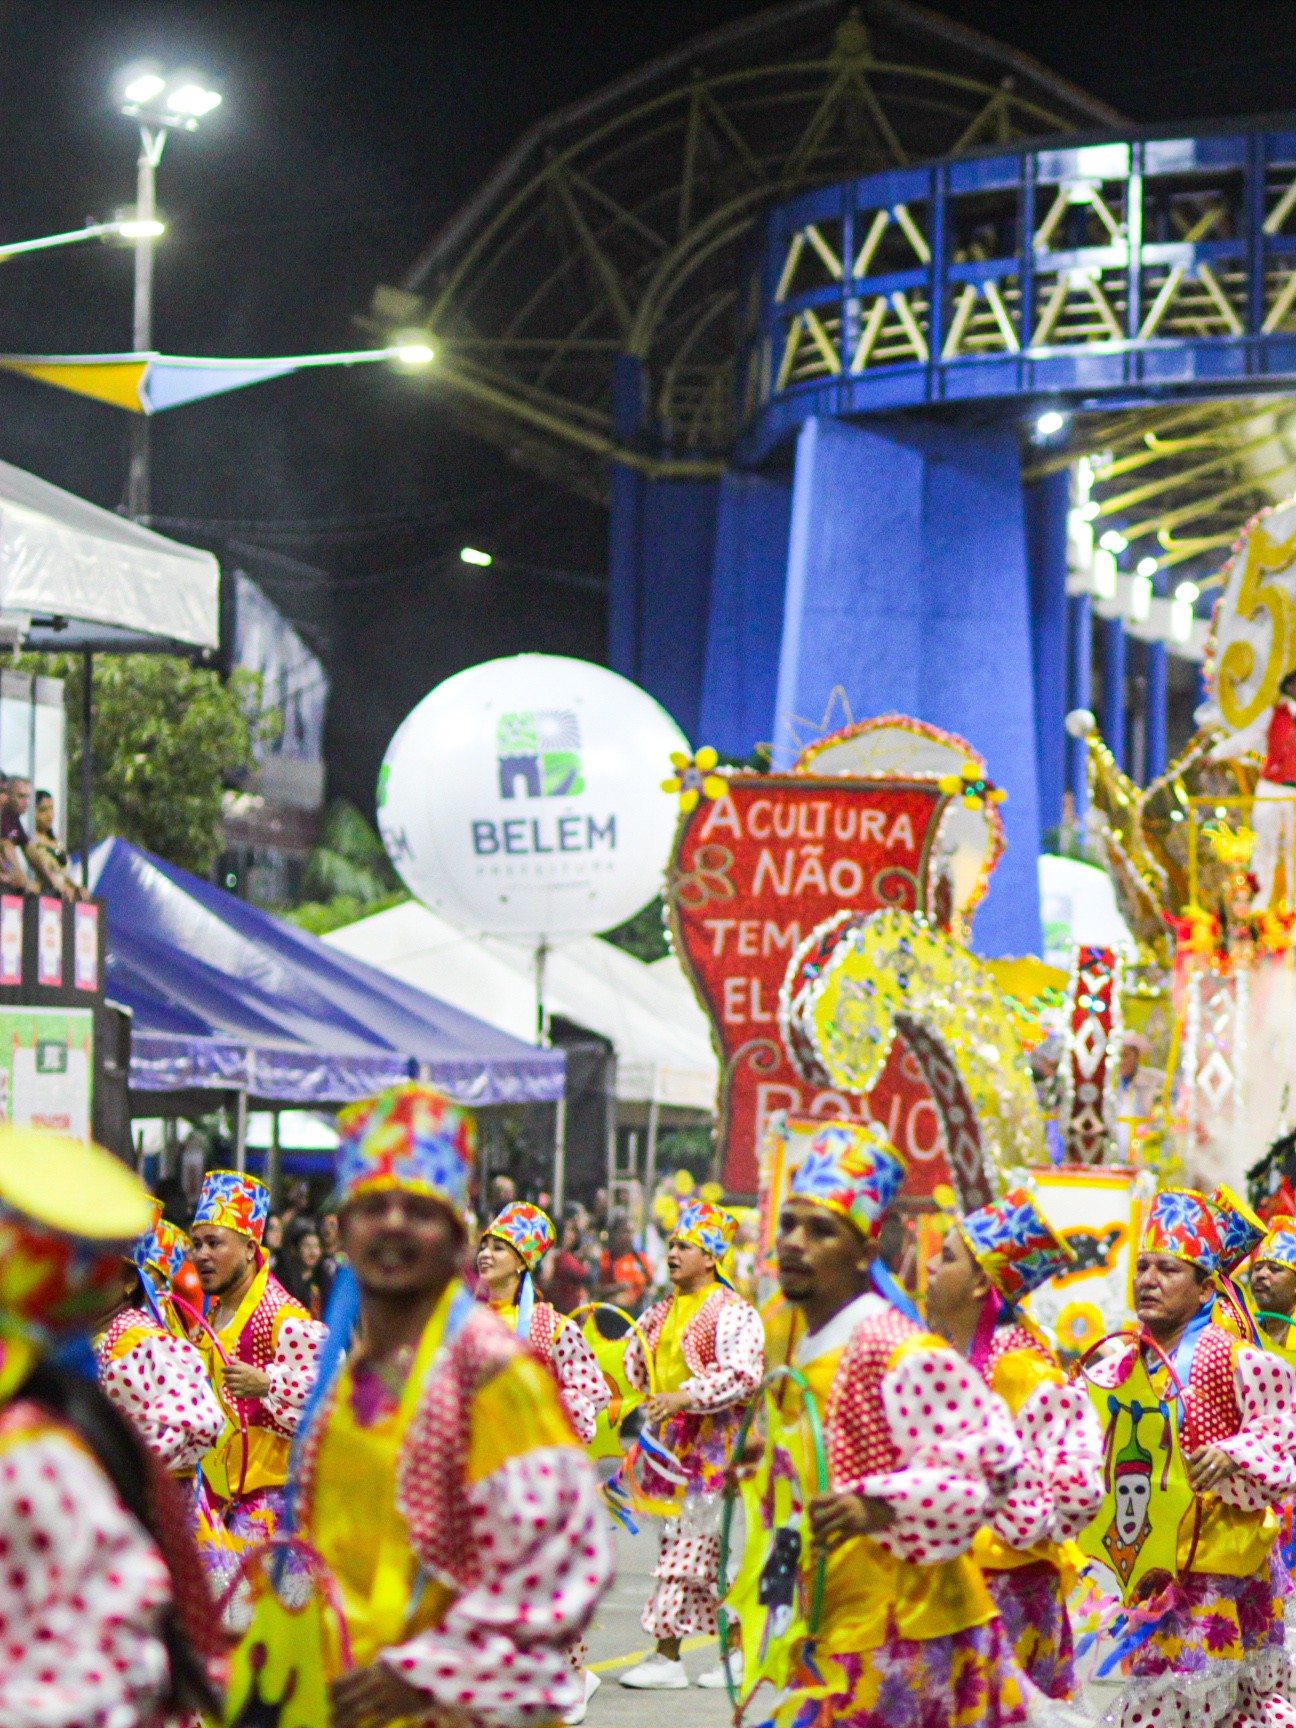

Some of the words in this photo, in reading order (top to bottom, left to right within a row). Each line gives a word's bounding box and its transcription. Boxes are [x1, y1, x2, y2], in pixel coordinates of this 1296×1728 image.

[702, 798, 742, 838] A
[746, 799, 914, 850] CULTURA
[752, 845, 864, 898] NÃO
[703, 919, 799, 957] TEM
[723, 977, 772, 1024] EL
